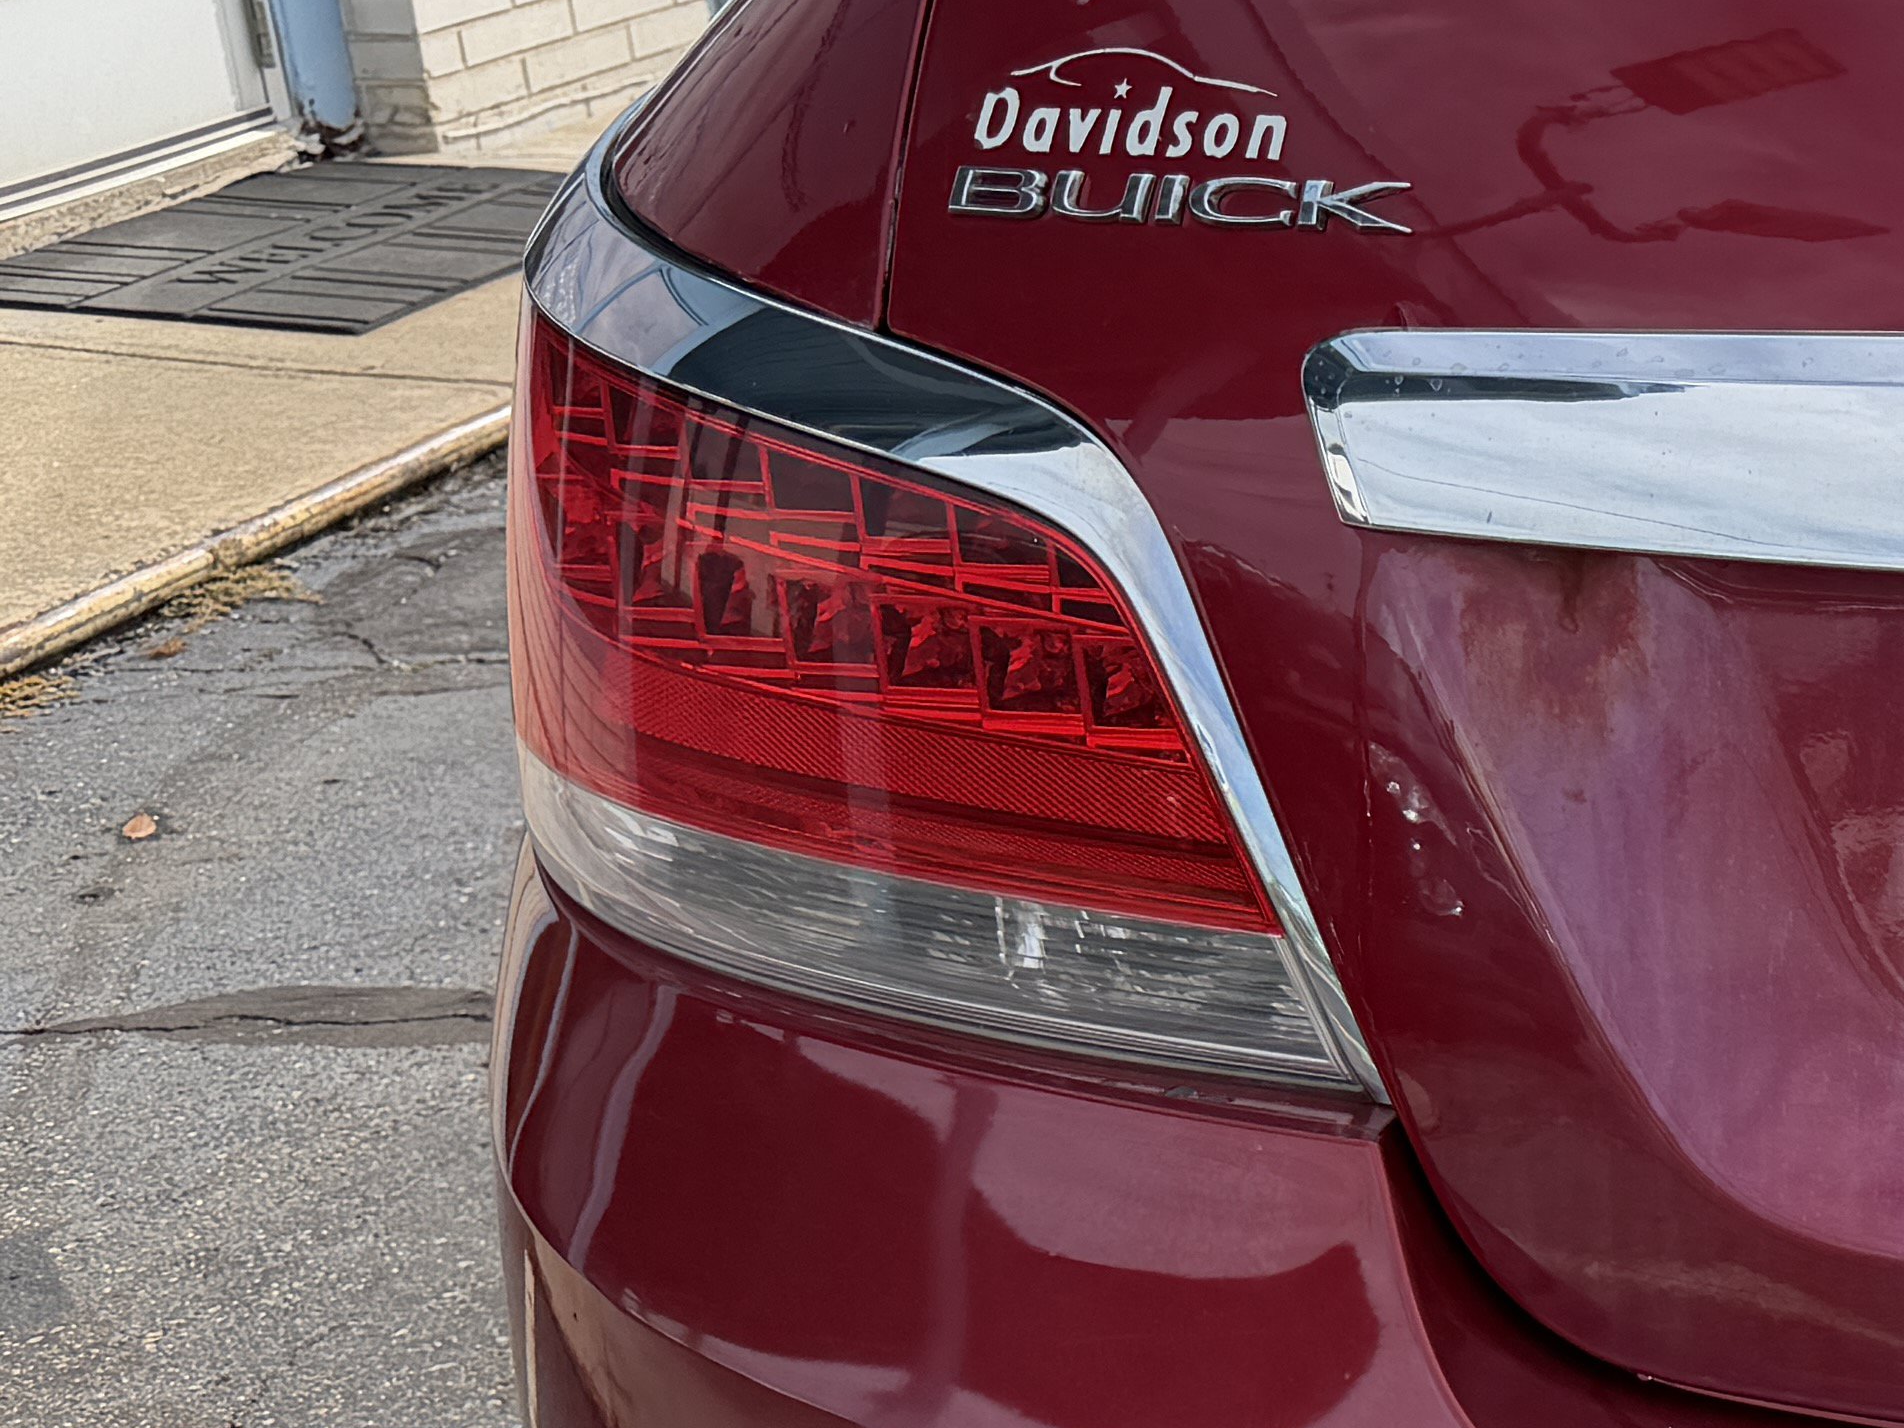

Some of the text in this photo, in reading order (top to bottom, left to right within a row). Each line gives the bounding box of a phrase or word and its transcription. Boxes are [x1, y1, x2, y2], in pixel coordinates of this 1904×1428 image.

[974, 86, 1288, 161] Davidson
[172, 182, 500, 285] WELCOME
[948, 164, 1413, 234] BUICK
